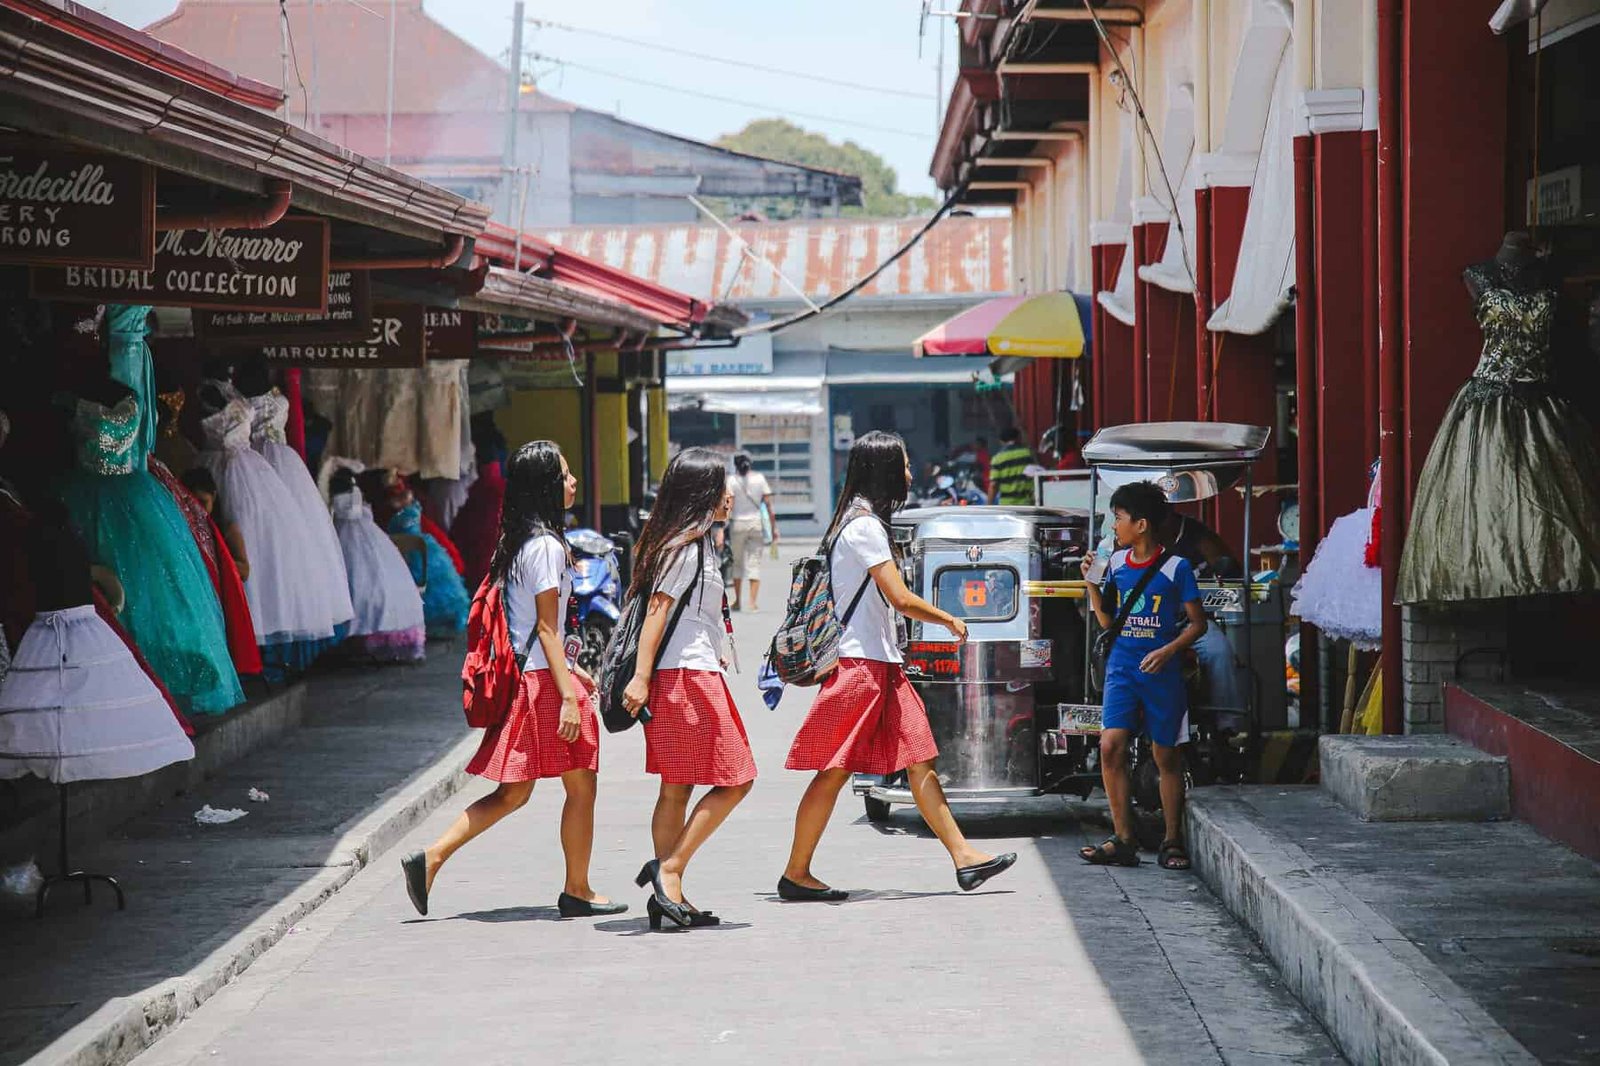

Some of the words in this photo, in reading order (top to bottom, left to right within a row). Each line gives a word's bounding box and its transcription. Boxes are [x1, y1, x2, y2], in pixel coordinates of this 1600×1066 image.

[2, 227, 71, 247] RONG
[66, 265, 154, 290] BRIDAL
[166, 268, 297, 297] COLLECTION
[263, 347, 379, 359] MARQUINEZ
